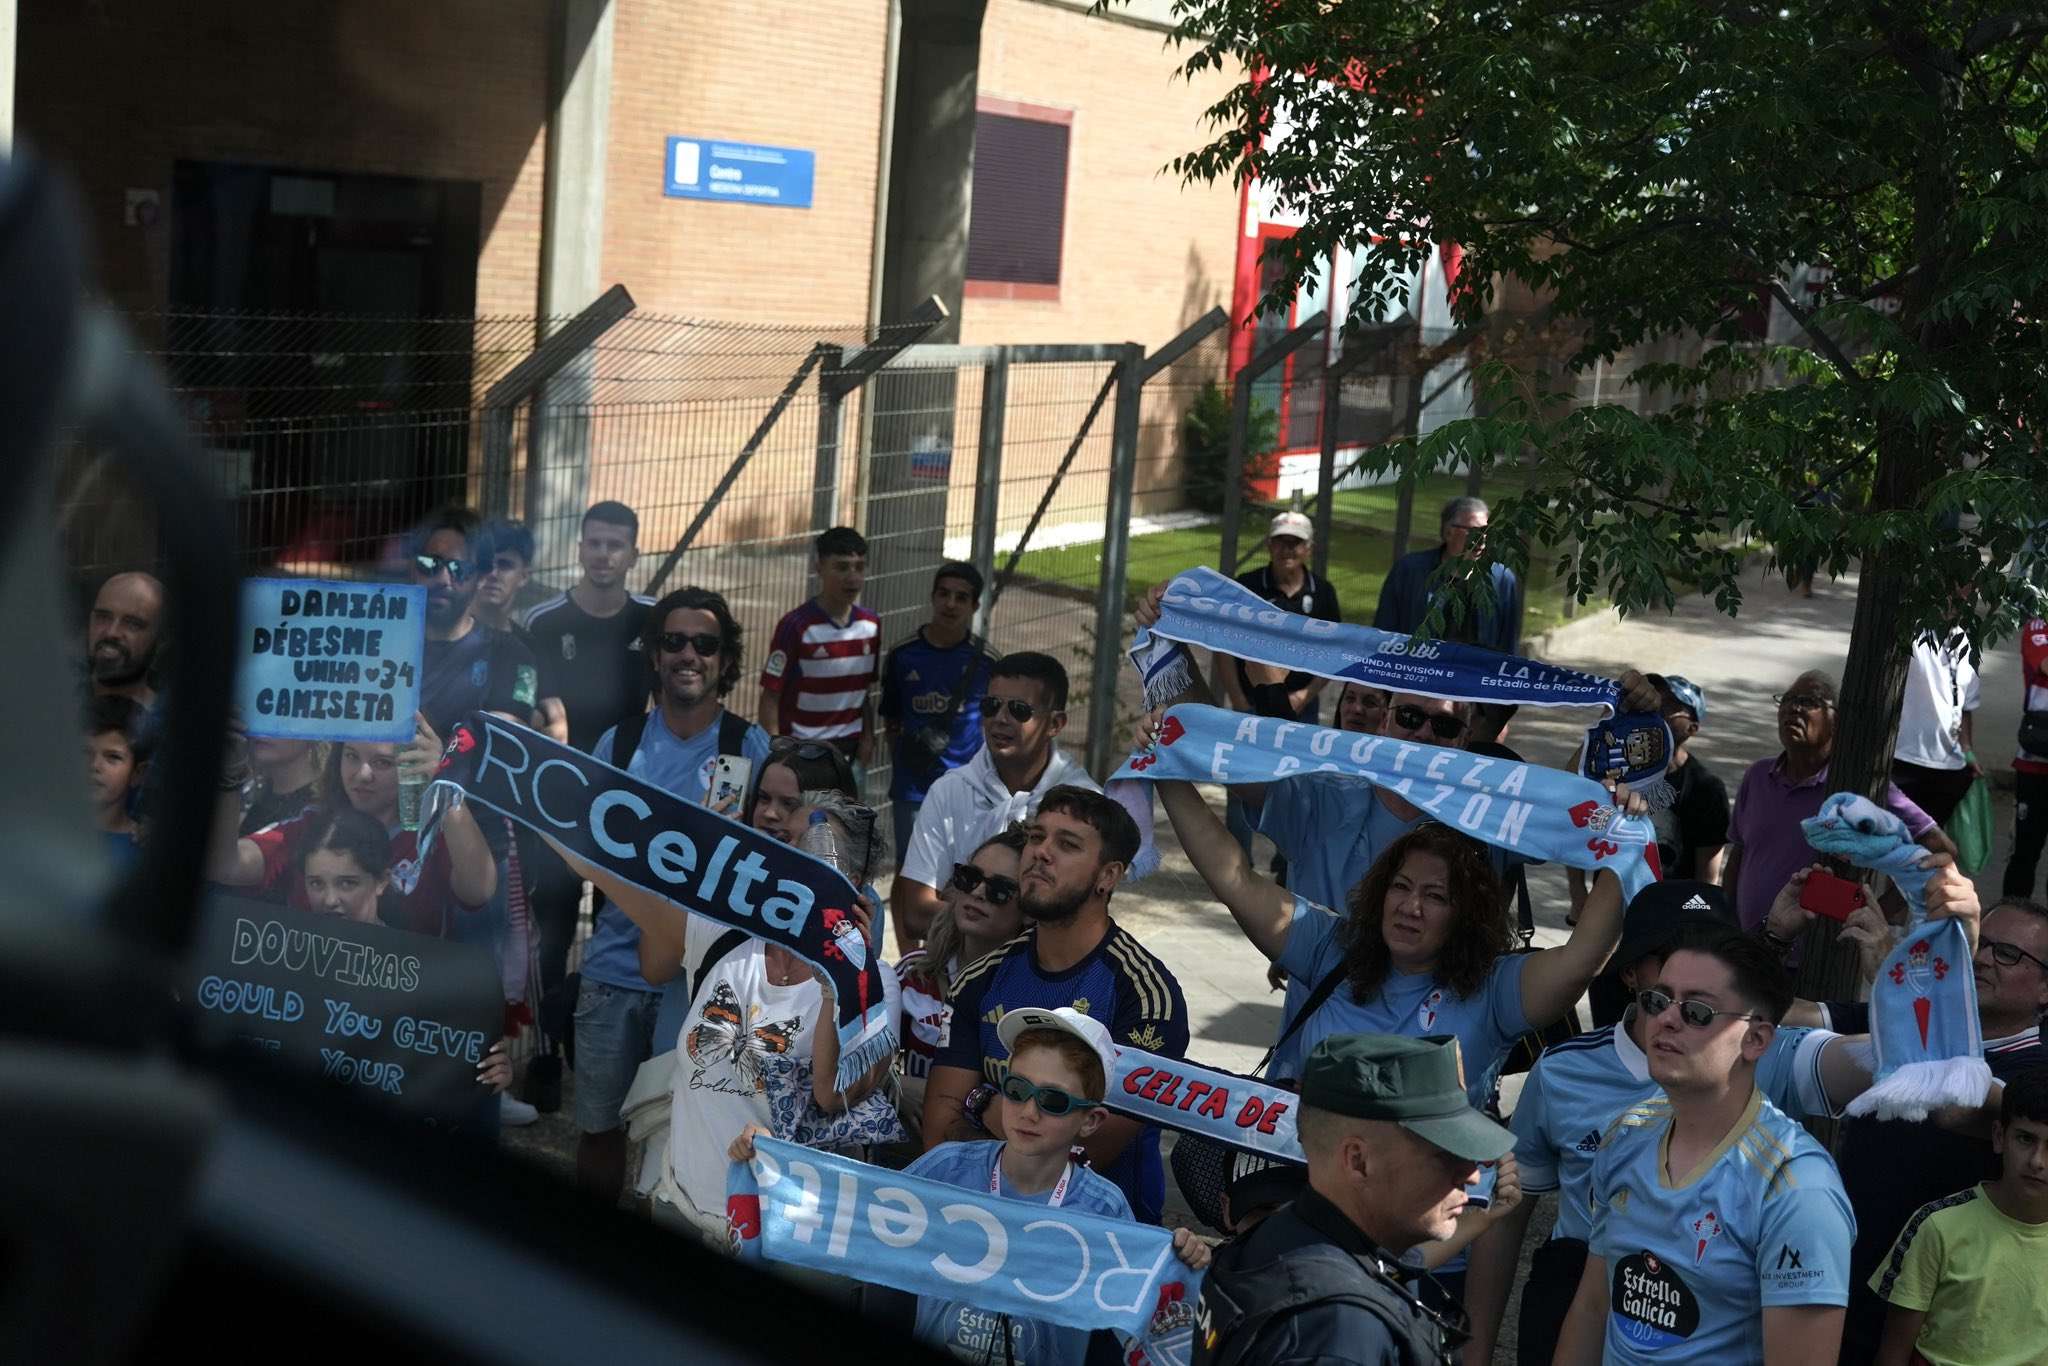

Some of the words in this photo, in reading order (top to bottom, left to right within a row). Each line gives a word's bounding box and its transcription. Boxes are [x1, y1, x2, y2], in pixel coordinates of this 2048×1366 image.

[281, 588, 408, 620] DAMIÁN
[252, 621, 383, 658] DÉBESME
[294, 659, 361, 684] UNHA
[380, 659, 415, 690] 34
[1363, 666, 1402, 680] Tempada
[1394, 662, 1444, 678] DIVISIÓN
[1447, 671, 1455, 679] B
[1481, 676, 1530, 689] Estadio
[1533, 682, 1550, 690] de
[1553, 683, 1595, 693] Riazor
[256, 687, 395, 722] CAMISETA
[1211, 742, 1234, 781] E
[1234, 717, 1529, 797] AFOUTEZA
[589, 789, 816, 938] Celta
[232, 918, 420, 992] DOUVIKAS
[199, 976, 304, 1022] COULD
[393, 1016, 485, 1064] GIVE
[320, 1048, 405, 1095] YOUR
[1122, 1066, 1229, 1120] CELTA
[1235, 1096, 1289, 1135] DE
[1623, 1266, 1681, 1307] Estrella
[1623, 1289, 1677, 1328] Galicia
